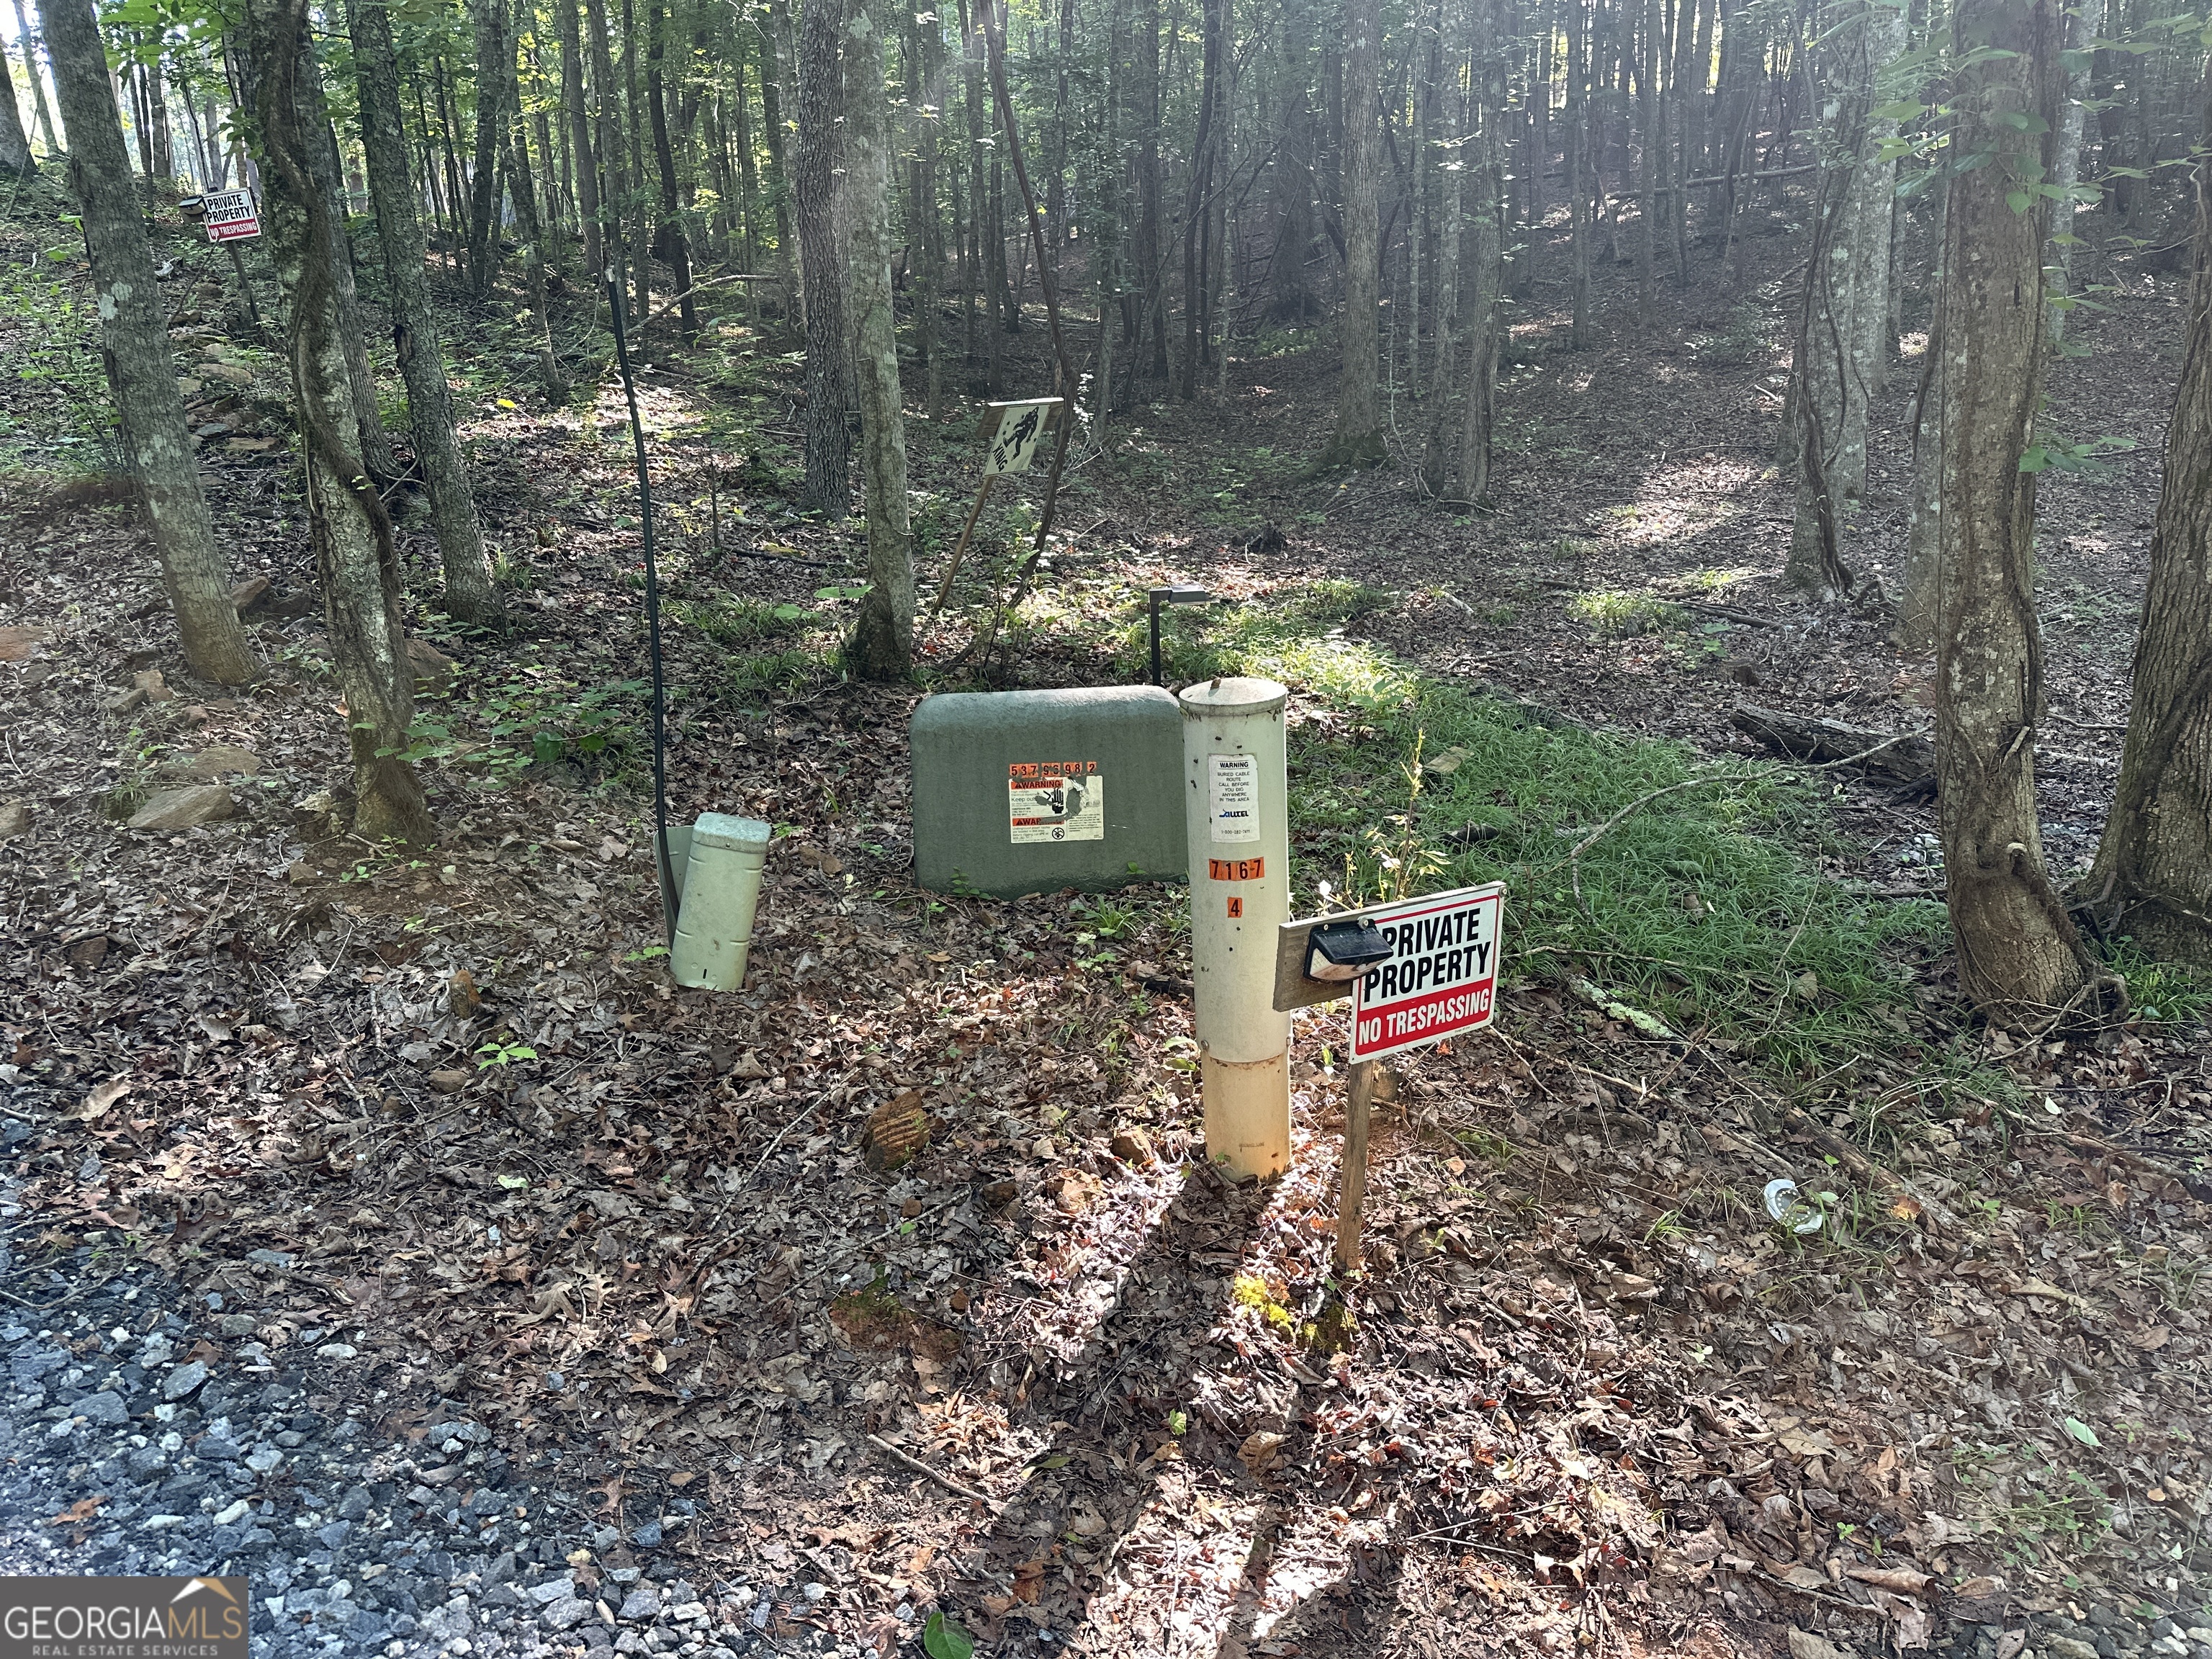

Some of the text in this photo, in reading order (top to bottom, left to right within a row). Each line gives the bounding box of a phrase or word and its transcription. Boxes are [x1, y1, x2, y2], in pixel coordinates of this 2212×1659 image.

[207, 194, 243, 210] PRIVATE
[207, 206, 251, 223] PROPERTY
[210, 222, 258, 237] NO TRESPASSING
[993, 443, 1008, 472] XING
[1012, 765, 1036, 776] 537
[1066, 764, 1081, 774] 98
[1089, 764, 1095, 773] 2
[1021, 780, 1061, 789] WARNING
[1231, 899, 1240, 917] 4
[1381, 907, 1481, 958] PRIVATE
[1364, 941, 1491, 1003] PROPERTY
[1358, 987, 1491, 1046] NO TRESPASSING
